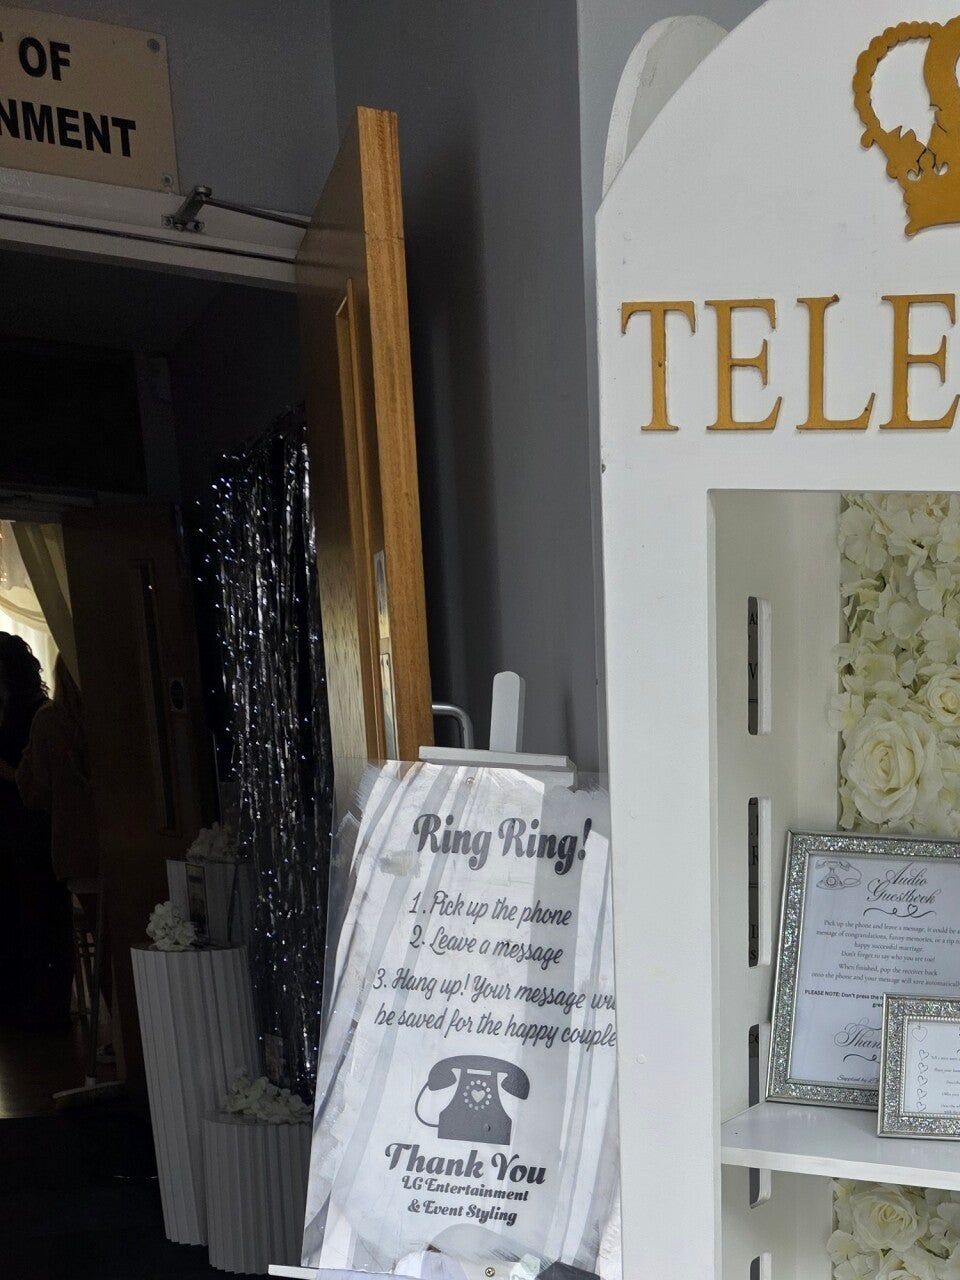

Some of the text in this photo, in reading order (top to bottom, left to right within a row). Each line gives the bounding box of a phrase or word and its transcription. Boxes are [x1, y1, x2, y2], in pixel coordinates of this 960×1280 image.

[19, 37, 71, 81] OF
[413, 813, 593, 876] Ring Ring!
[866, 879, 942, 905] Guestbook
[884, 860, 929, 886] Audio
[409, 890, 573, 929] 1. Pick up the phone
[410, 924, 564, 970] 2. Leave a message
[372, 968, 387, 990] 3.
[391, 968, 438, 1000] Hang
[439, 973, 471, 1001] up!
[472, 975, 511, 1003] Your
[514, 984, 585, 1015] message
[374, 1003, 616, 1052] be saved for the happy couple
[384, 1142, 547, 1185] Thank You
[401, 1175, 529, 1201] LG Entertainment
[407, 1198, 518, 1227] & Event Styling
